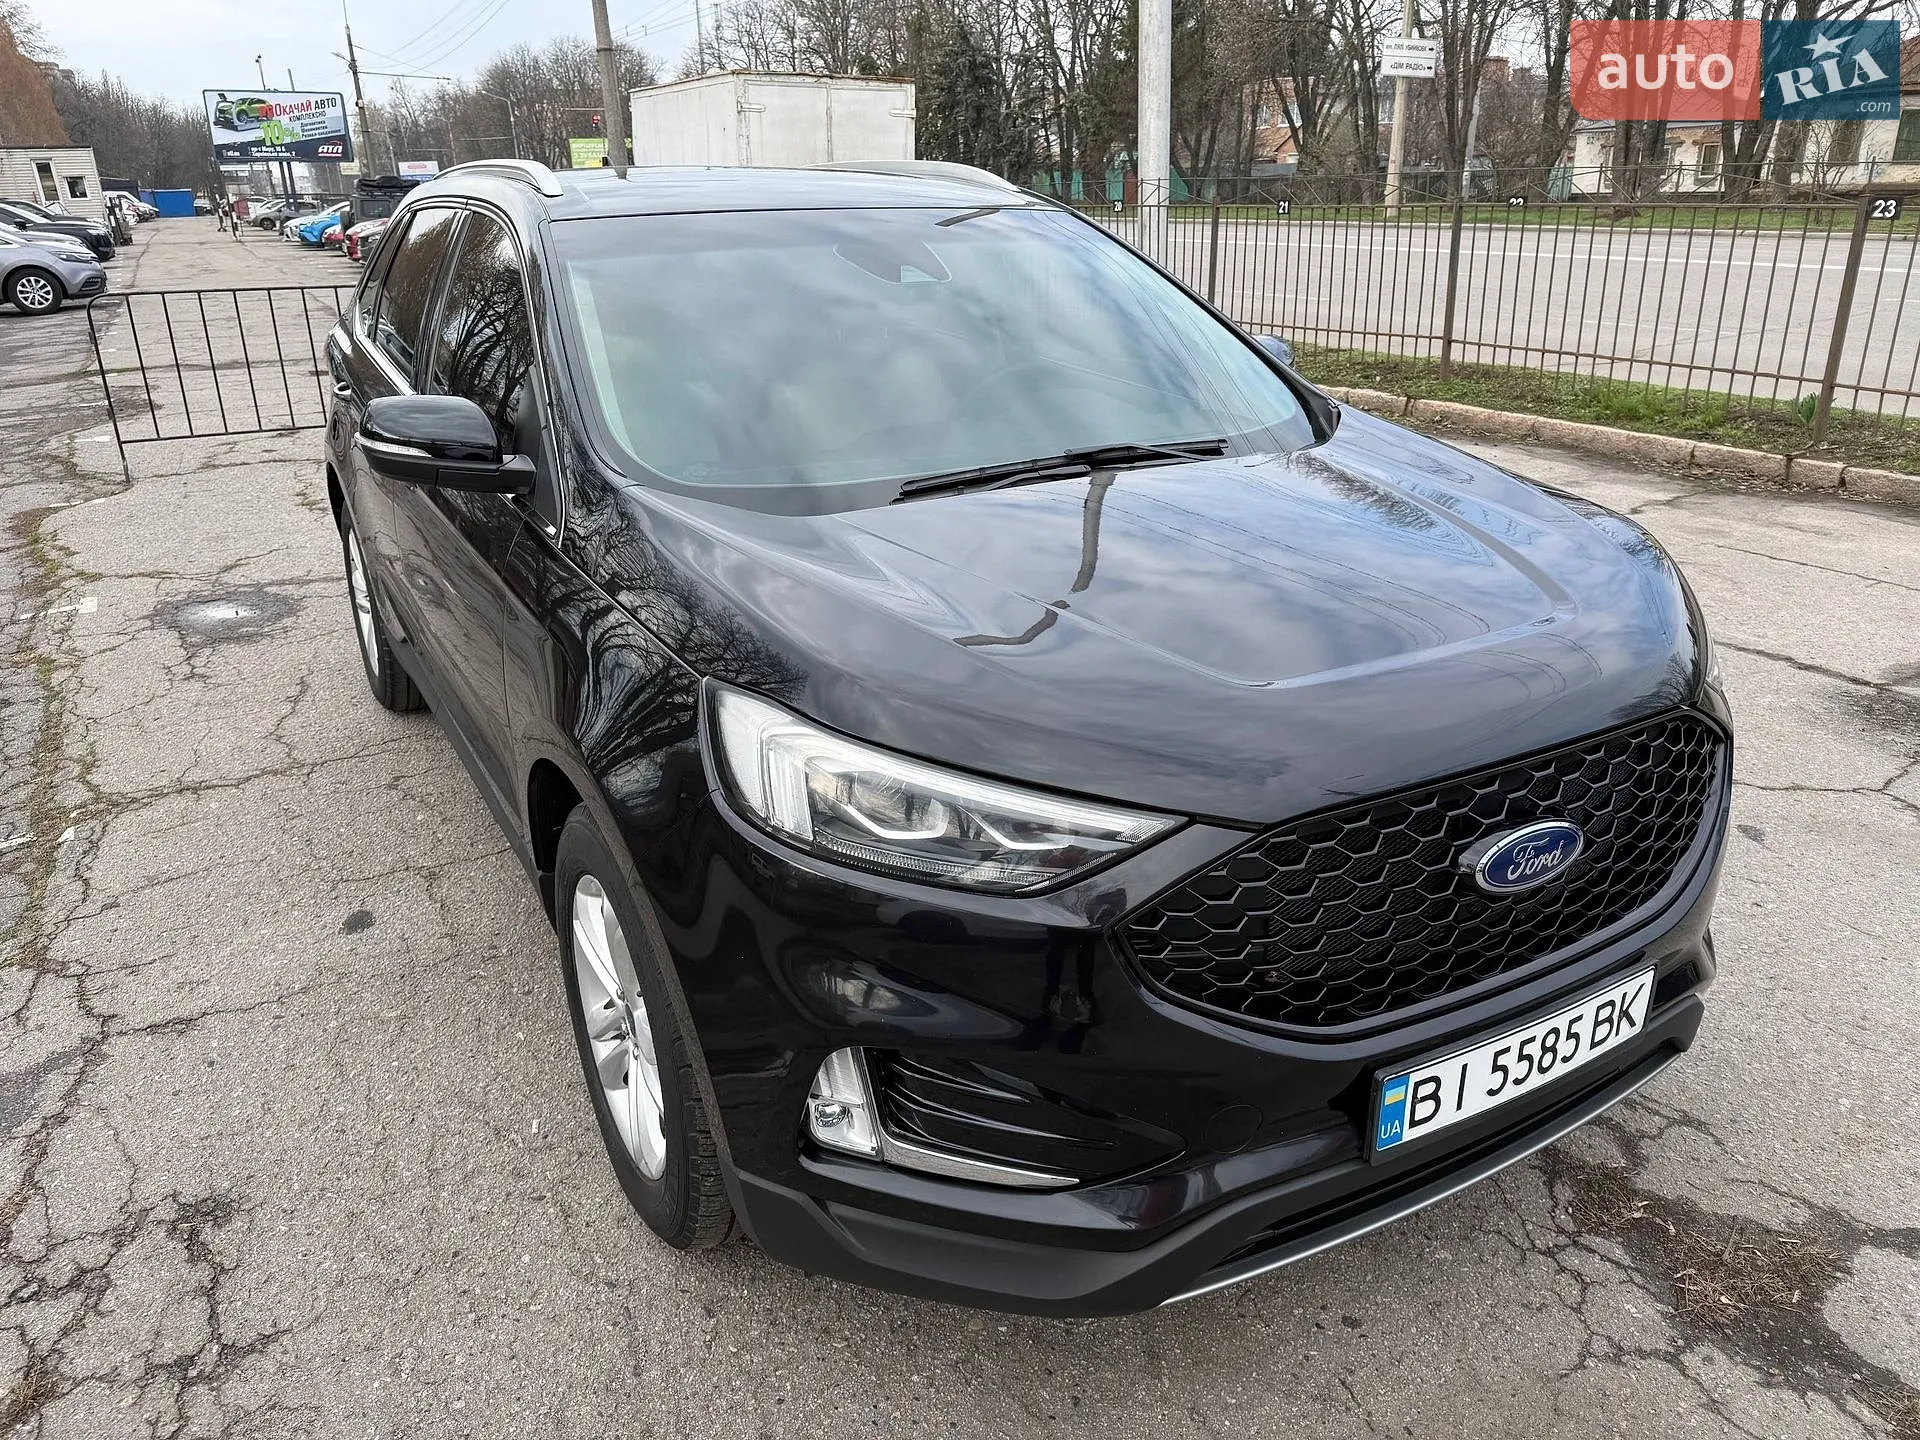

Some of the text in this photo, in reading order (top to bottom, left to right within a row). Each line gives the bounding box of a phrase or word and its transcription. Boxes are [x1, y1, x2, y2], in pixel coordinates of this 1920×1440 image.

[314, 97, 337, 111] АВТО
[1278, 202, 1288, 212] 21
[1872, 199, 1897, 218] 23
[1507, 836, 1565, 881] Ford
[1486, 1013, 1584, 1098] 5585
[1589, 982, 1646, 1051] BK
[1381, 1121, 1401, 1140] UA
